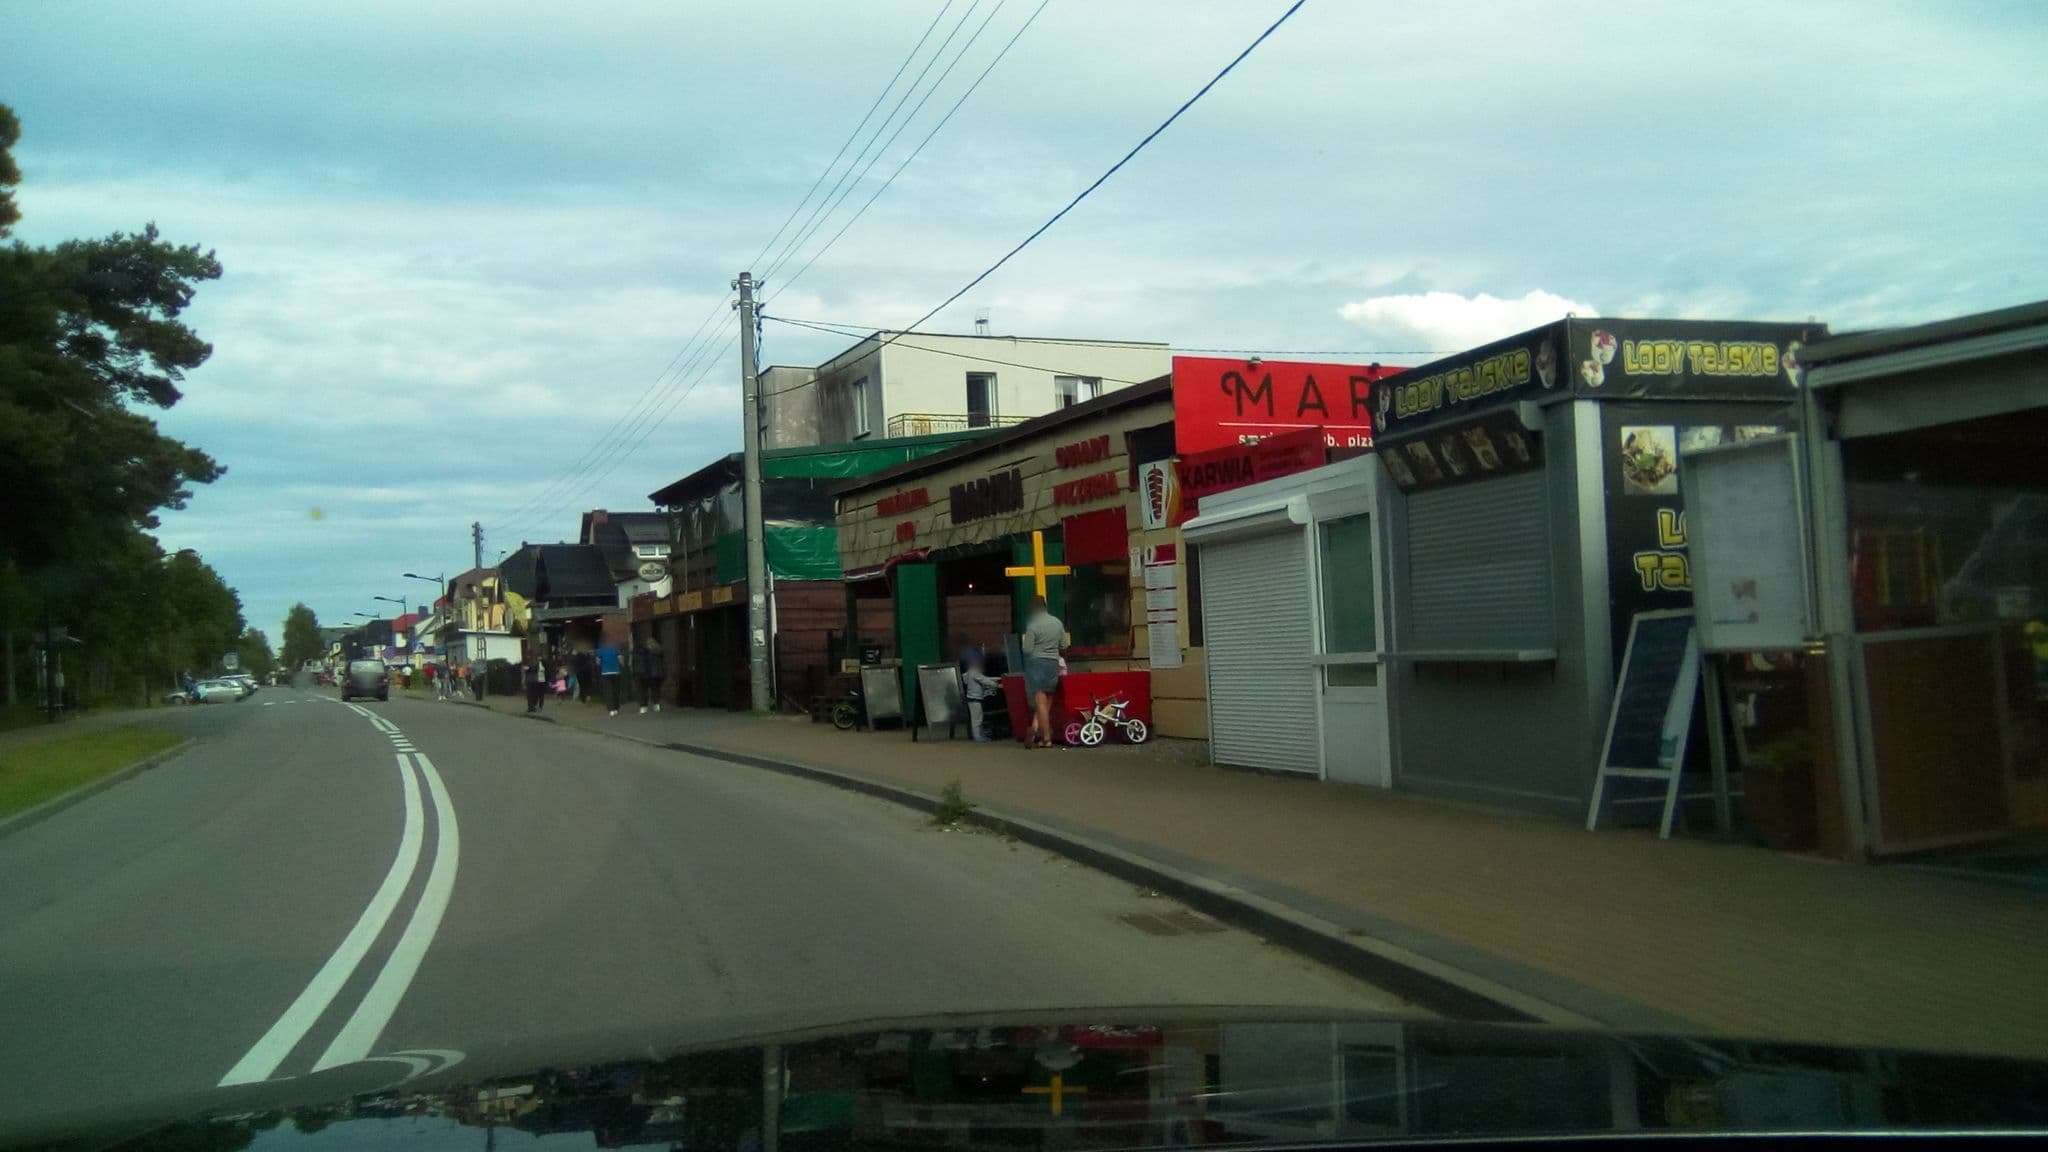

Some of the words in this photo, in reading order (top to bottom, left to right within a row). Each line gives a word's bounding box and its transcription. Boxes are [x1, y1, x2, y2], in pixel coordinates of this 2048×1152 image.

[1622, 340, 1686, 375] LODY
[1395, 374, 1444, 419] LODY
[1182, 456, 1255, 489] KARWIA
